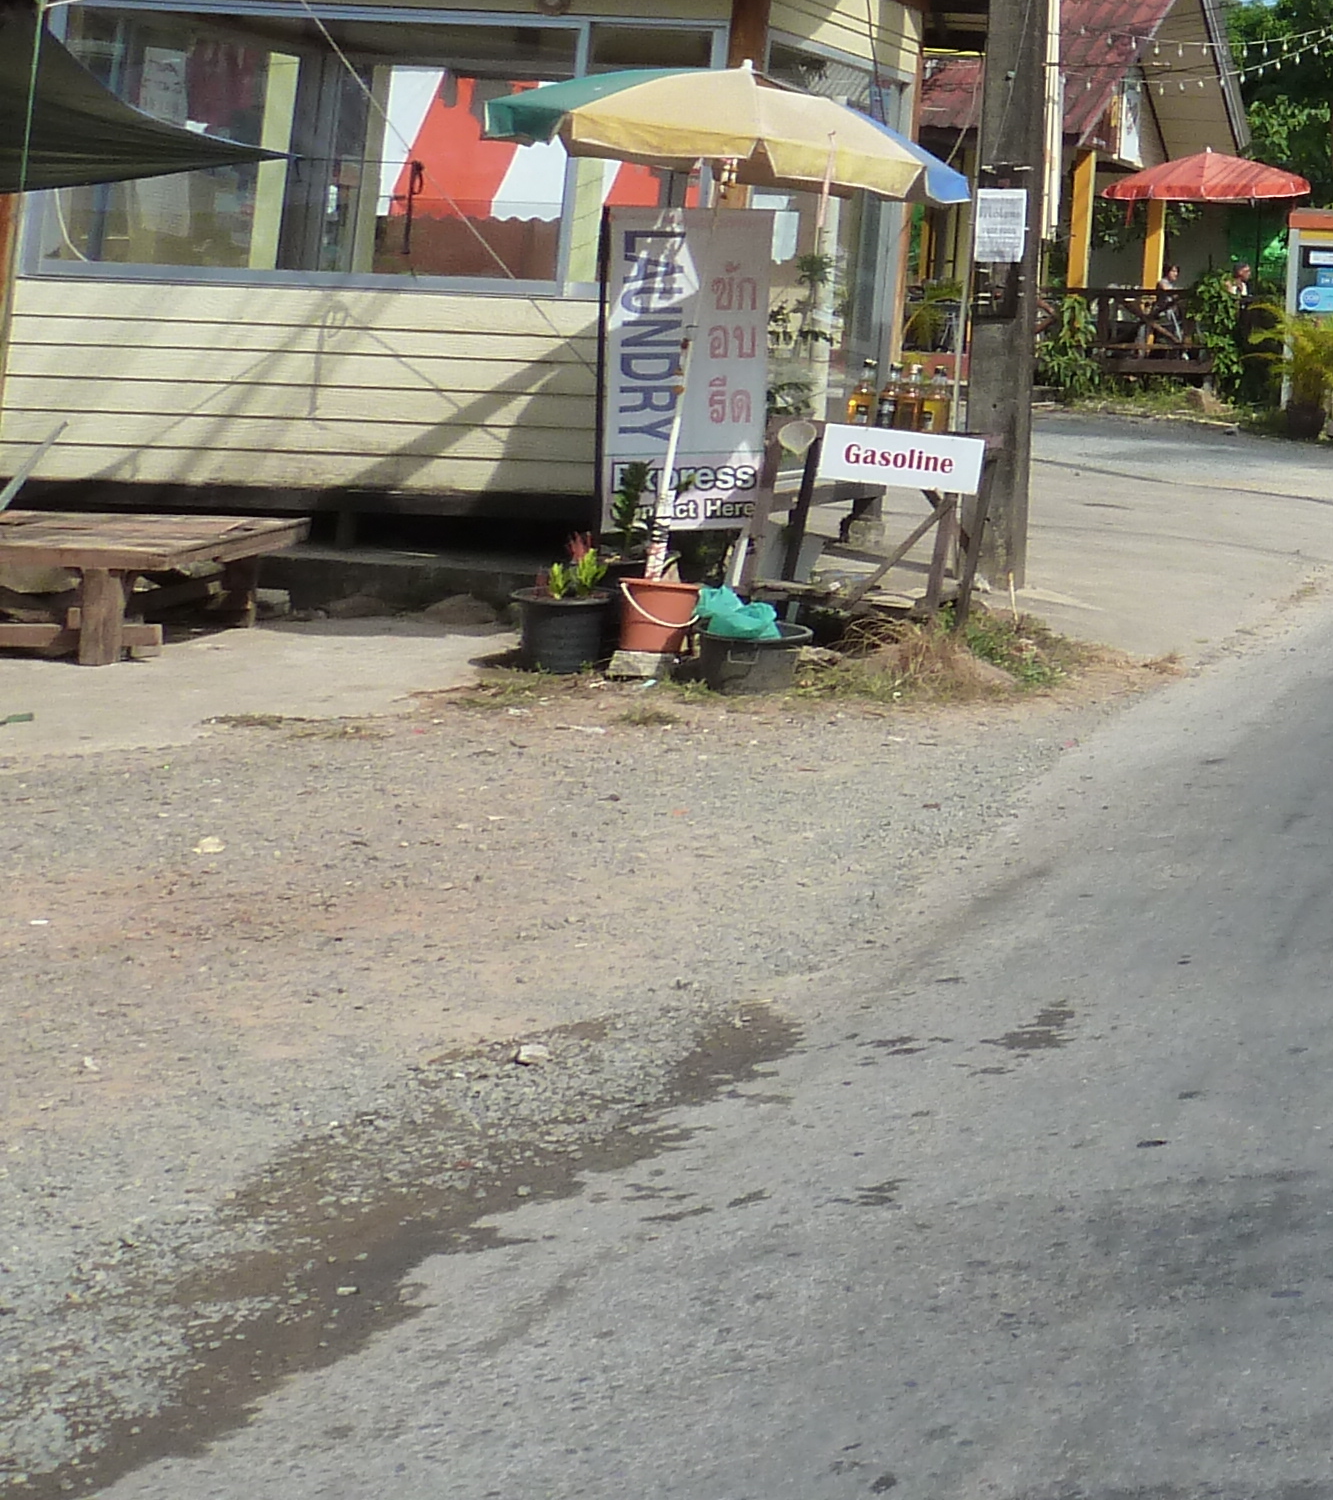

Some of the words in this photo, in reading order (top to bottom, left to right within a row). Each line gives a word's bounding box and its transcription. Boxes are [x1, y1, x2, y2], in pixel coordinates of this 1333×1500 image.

[618, 230, 687, 441] LAUNDRY
[708, 325, 756, 360] อบ
[708, 375, 753, 424] รีด
[844, 443, 954, 474] Gasoline
[703, 498, 756, 519] Here
